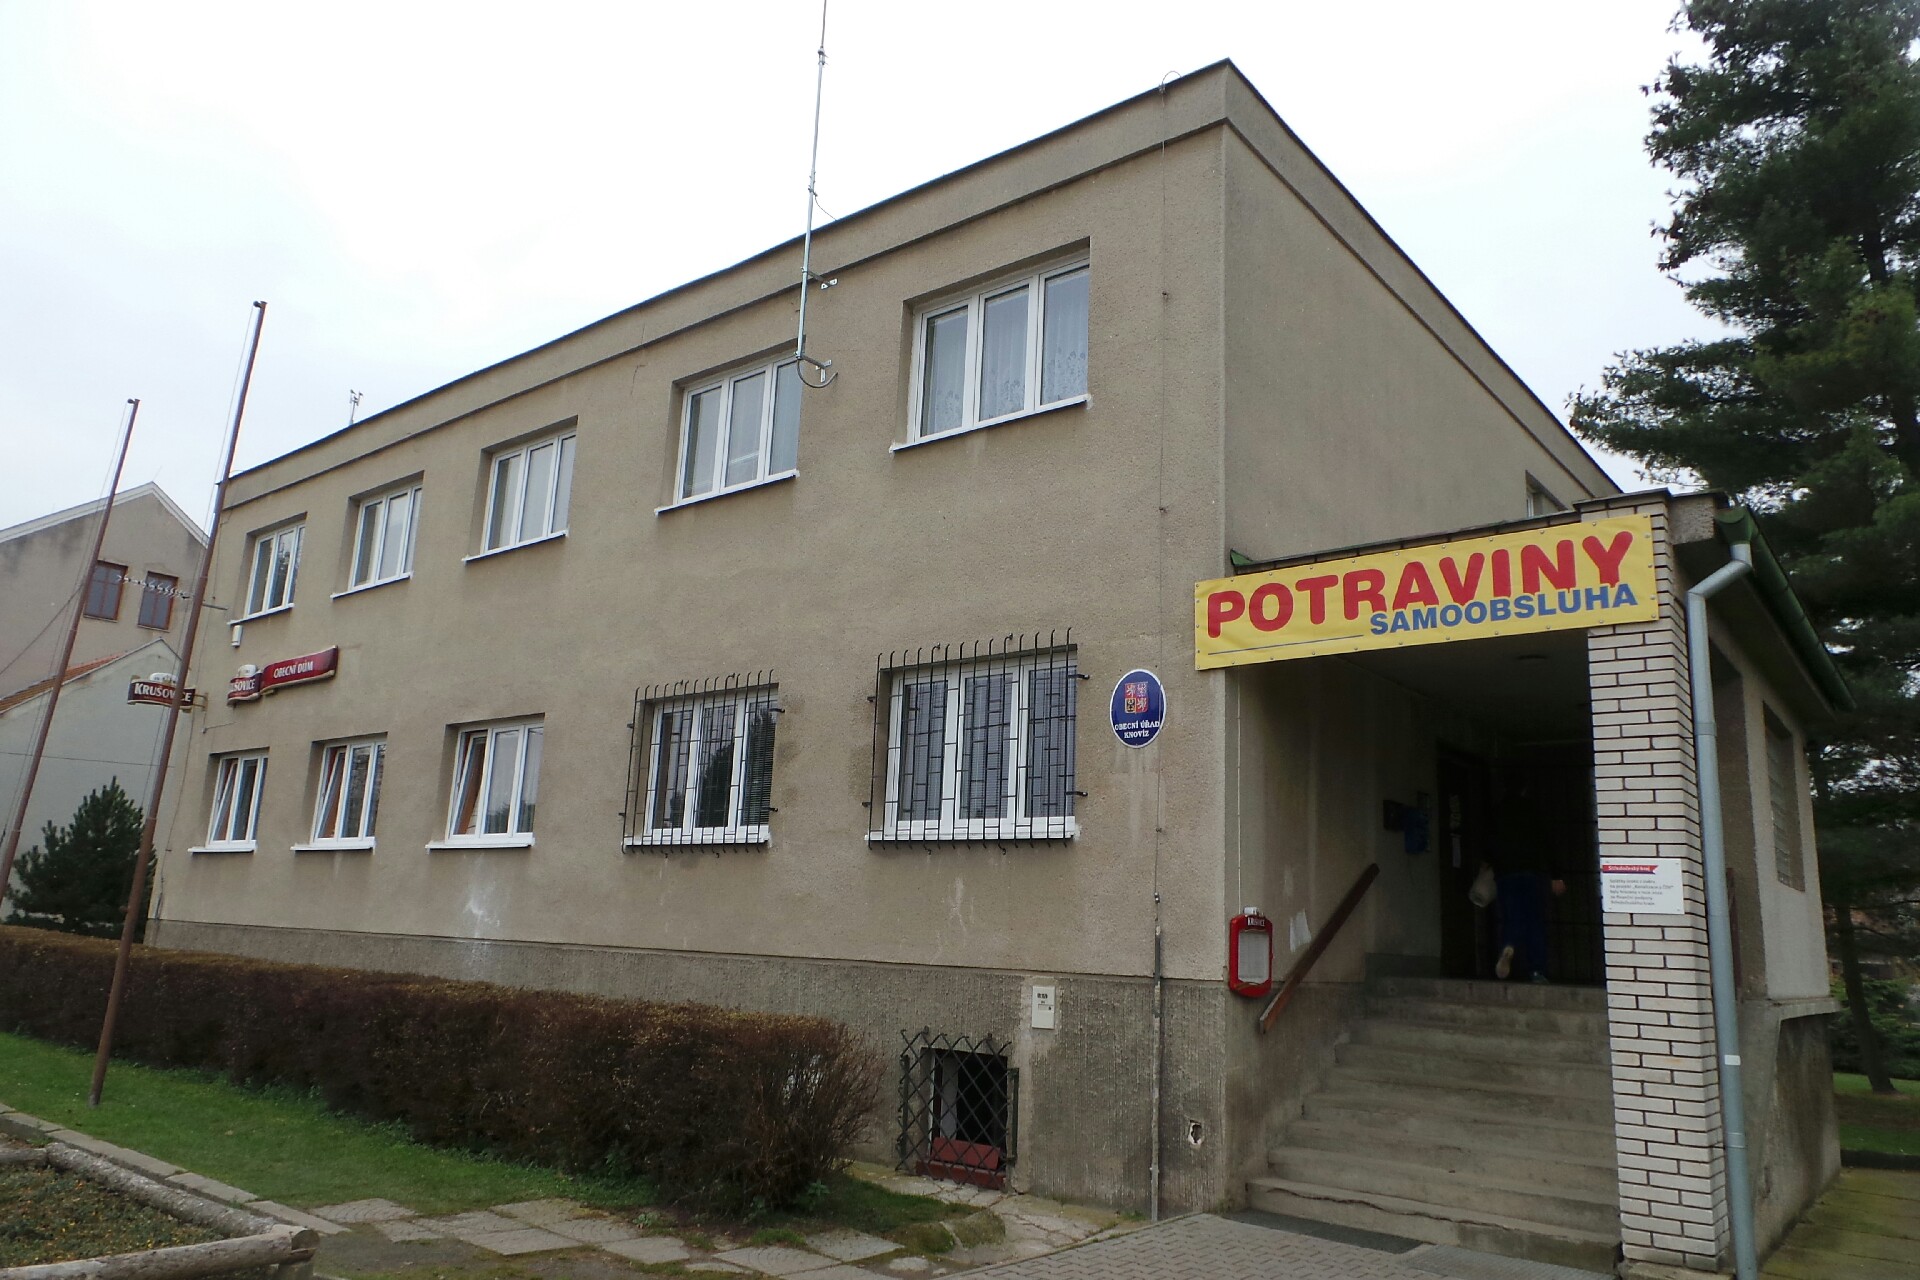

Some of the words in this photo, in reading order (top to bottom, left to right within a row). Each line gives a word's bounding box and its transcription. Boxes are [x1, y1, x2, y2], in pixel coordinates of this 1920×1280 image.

[1207, 531, 1633, 639] POTRAVINY
[1370, 583, 1638, 635] SAMOOBSLUHA
[134, 682, 192, 702] KRUŠOVE
[1114, 720, 1138, 730] OBECNÍ
[1140, 720, 1160, 729] ÚŘAD
[1124, 729, 1150, 739] KNOVÍZ
